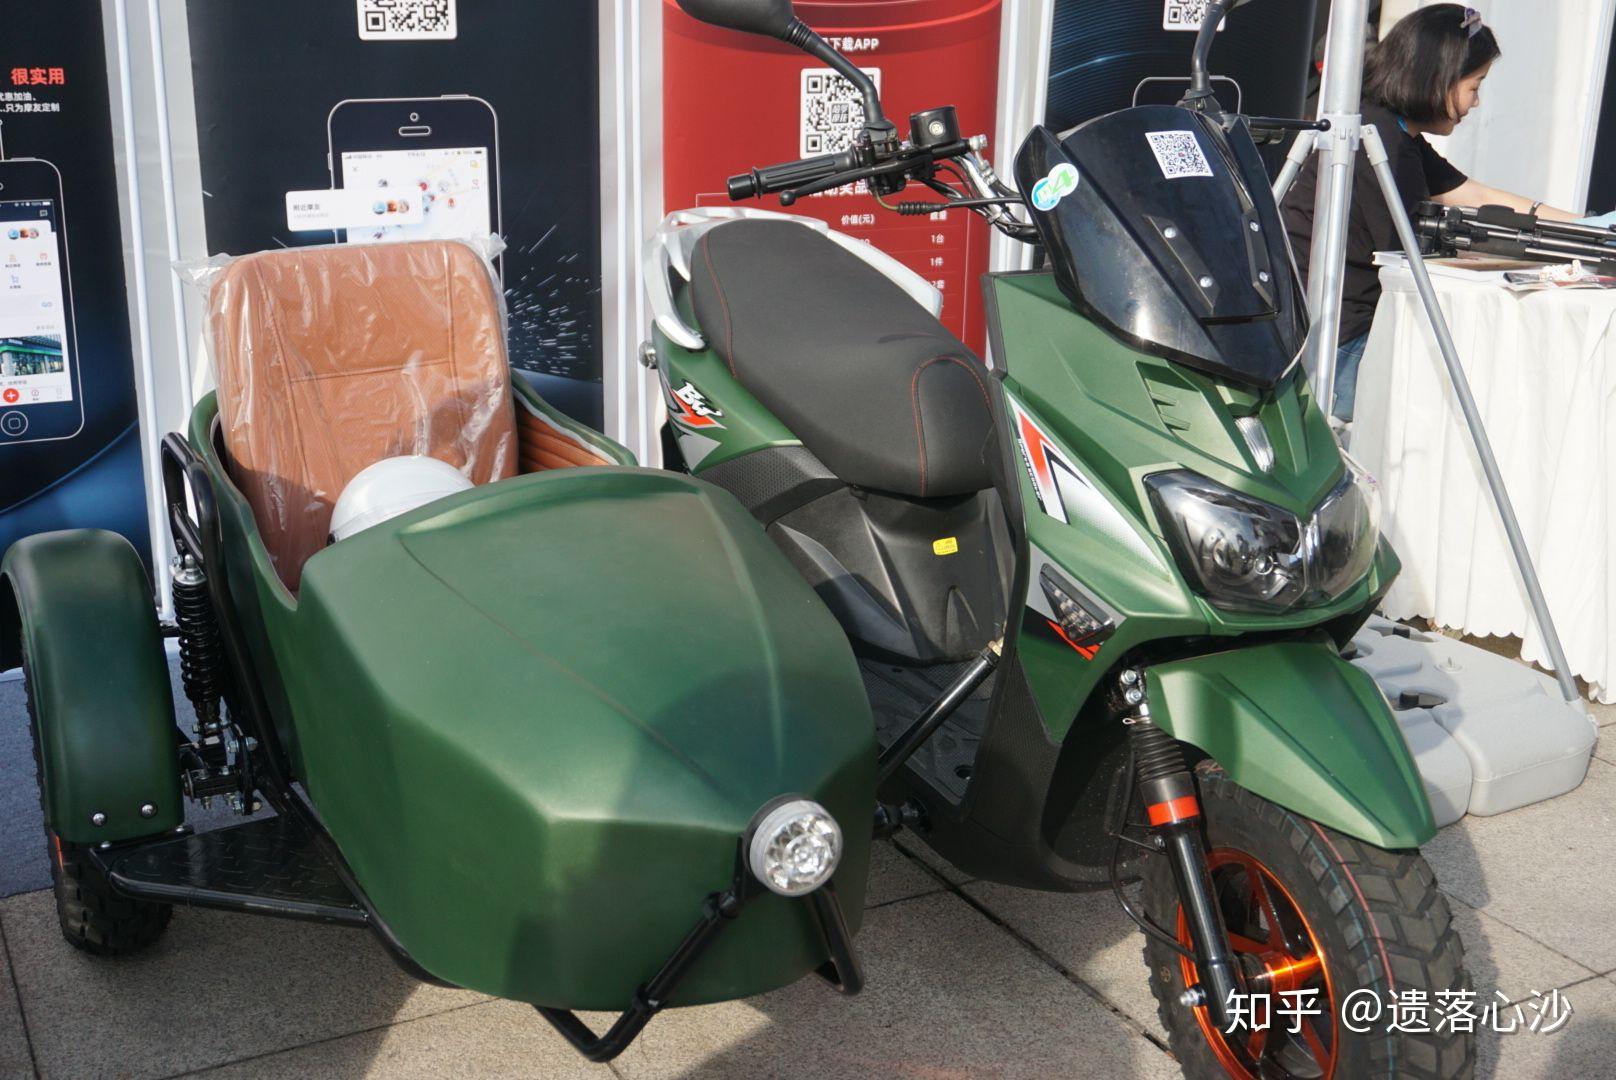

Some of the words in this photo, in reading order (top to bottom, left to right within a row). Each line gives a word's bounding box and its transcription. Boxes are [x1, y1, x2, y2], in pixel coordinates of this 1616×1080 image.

[822, 37, 880, 51] 下载APP
[11, 67, 65, 85] 很实用
[841, 214, 876, 225] 价值(元)
